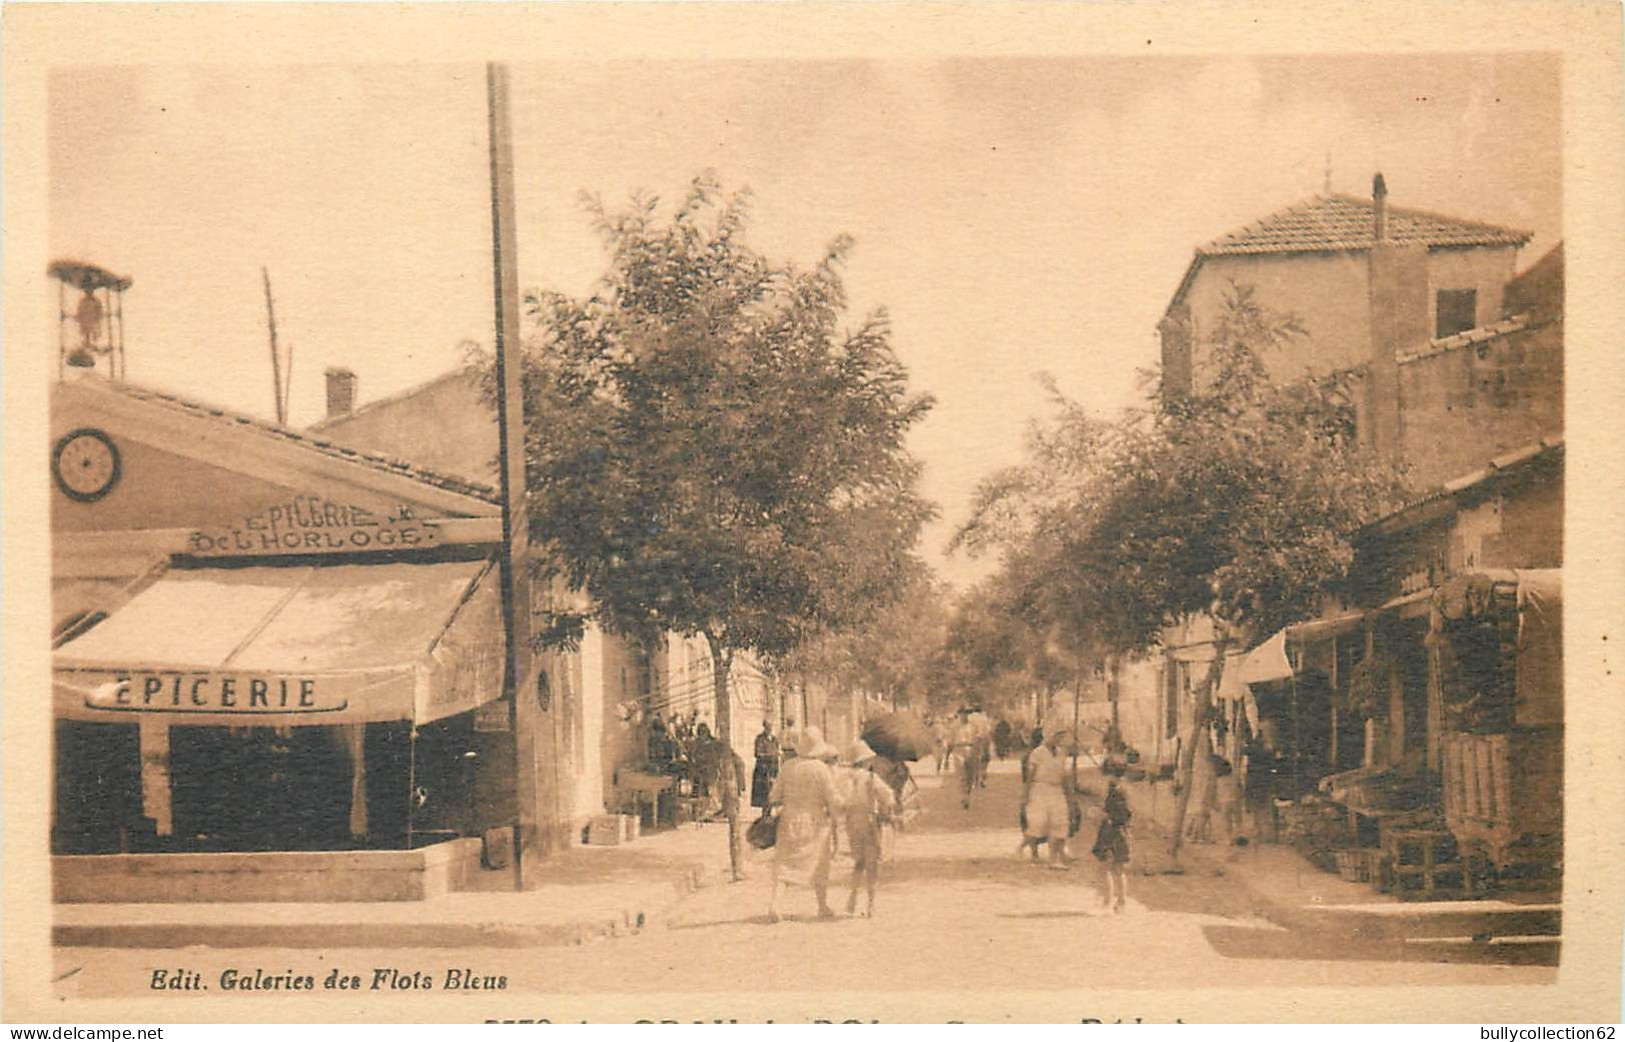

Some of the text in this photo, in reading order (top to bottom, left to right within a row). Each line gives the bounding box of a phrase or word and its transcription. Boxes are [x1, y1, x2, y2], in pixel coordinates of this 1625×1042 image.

[149, 968, 508, 991] Edit. Galeries des Flots Bleus
